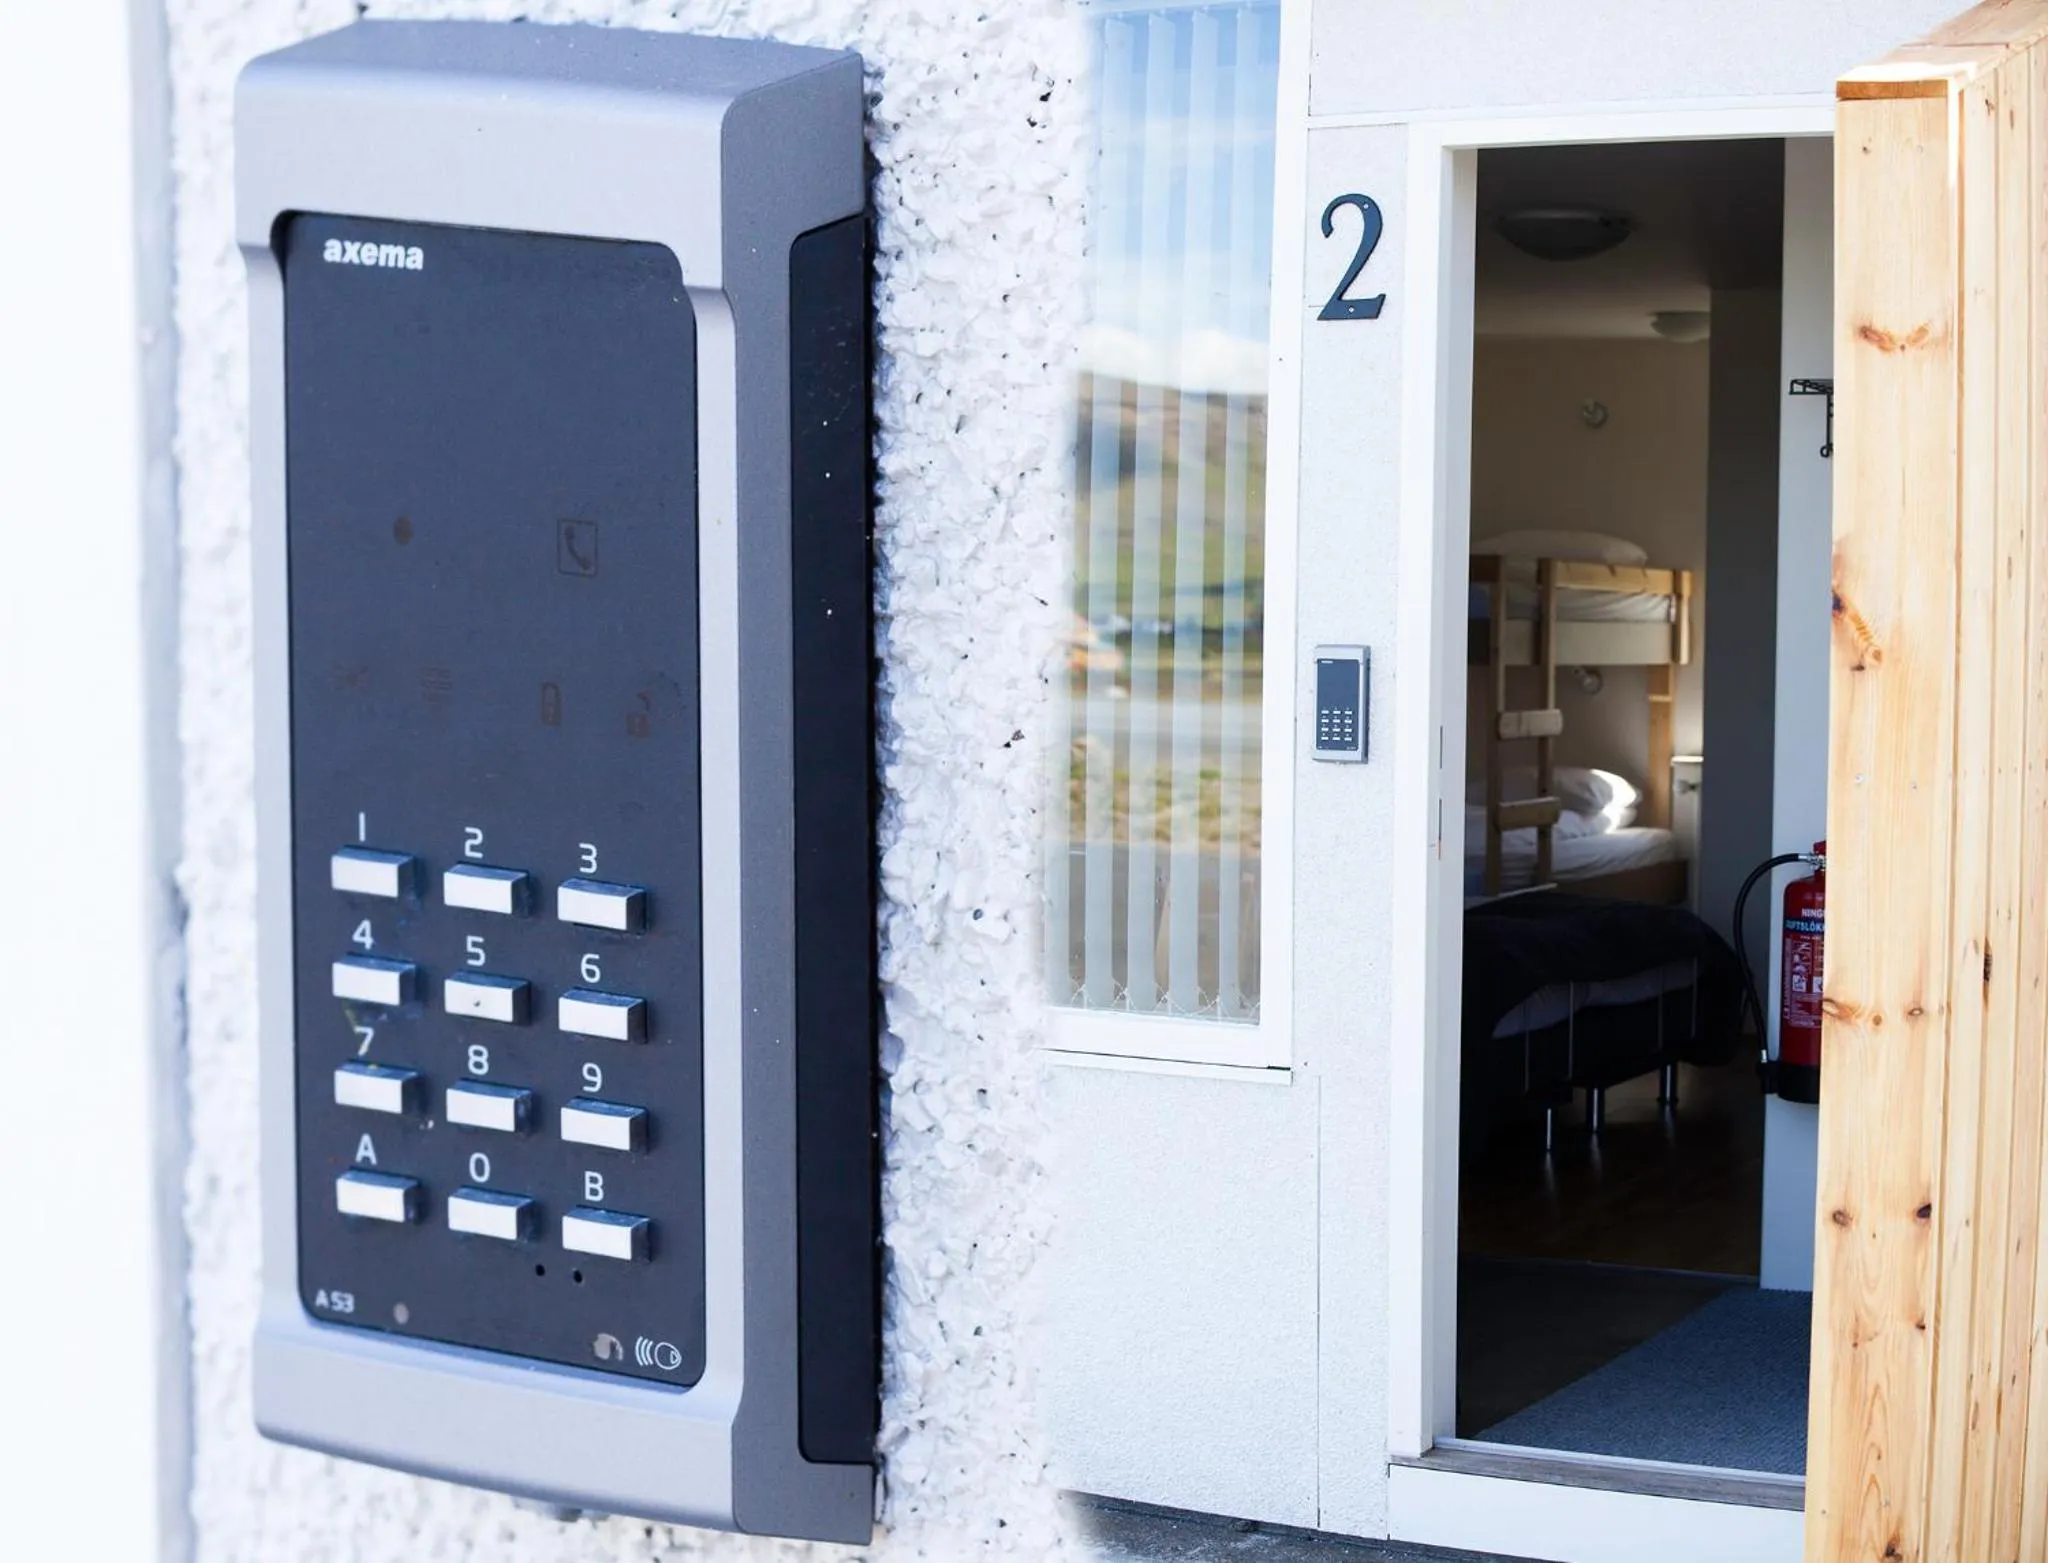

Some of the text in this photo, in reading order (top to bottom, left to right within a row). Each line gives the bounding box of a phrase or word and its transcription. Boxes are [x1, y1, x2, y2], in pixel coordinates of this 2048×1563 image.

[323, 238, 425, 270] axema
[1317, 193, 1386, 320] 2
[358, 811, 366, 842] 1
[464, 826, 484, 859] 2
[578, 842, 598, 874] 3
[352, 919, 374, 950] 4
[466, 935, 486, 967] 5
[580, 953, 601, 984] 6
[353, 1025, 375, 1057] 7
[467, 1044, 490, 1076] 8
[582, 1062, 603, 1093] 9
[355, 1133, 377, 1165] A
[584, 1170, 605, 1202] B
